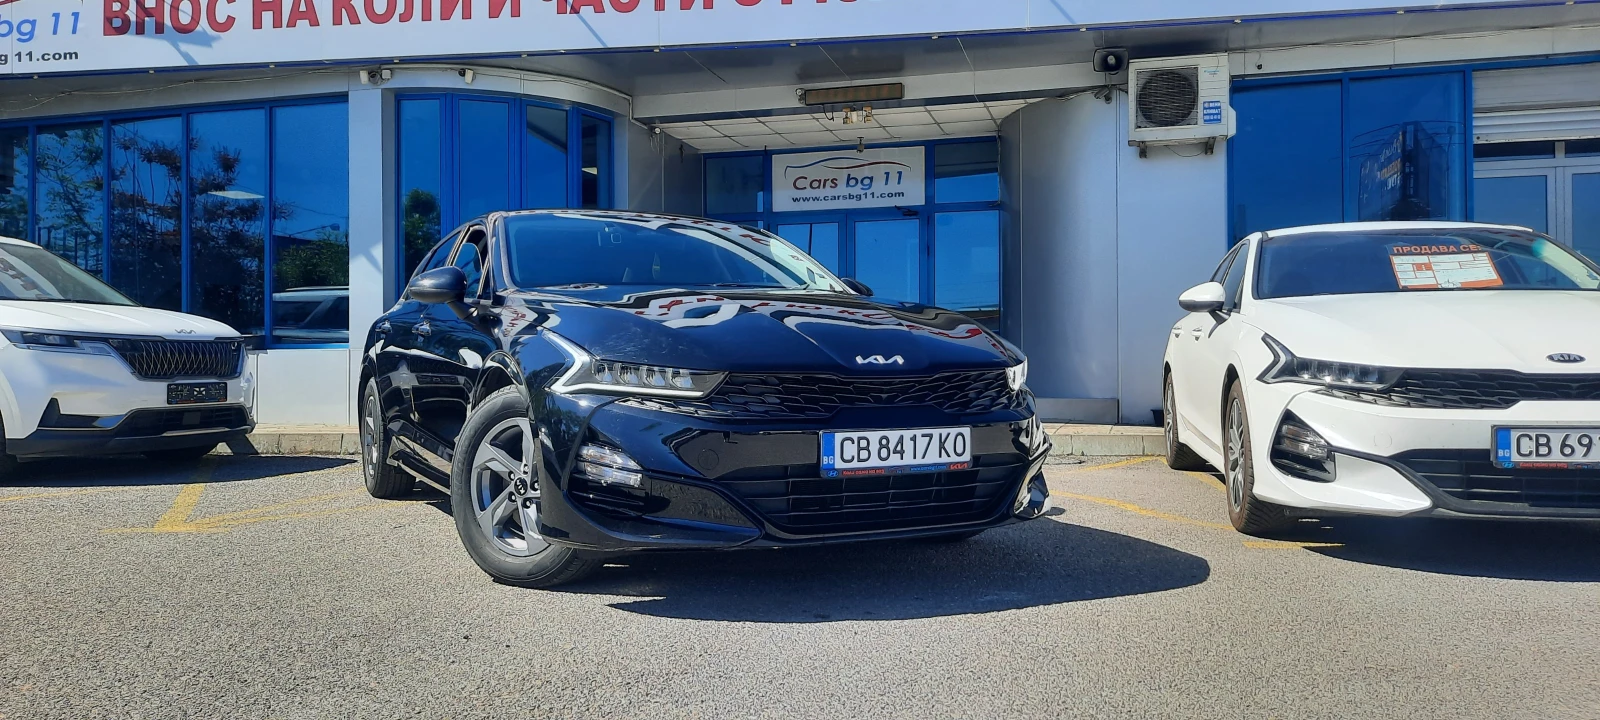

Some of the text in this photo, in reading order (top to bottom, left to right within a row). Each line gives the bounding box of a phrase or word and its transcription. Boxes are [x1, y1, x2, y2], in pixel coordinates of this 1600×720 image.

[51, 11, 80, 36] 11
[103, 0, 236, 36] ВНОС
[252, 0, 320, 30] НА
[792, 170, 903, 191] Cars bg 11
[792, 190, 905, 203] www.carsbg11.com
[1393, 245, 1457, 254] ПРОДАВА
[1550, 352, 1583, 361] KIA
[840, 431, 966, 464] CB 8417 KO
[1498, 449, 1510, 457] BG
[1515, 433, 1600, 457] CB 69
[823, 455, 834, 465] BG
